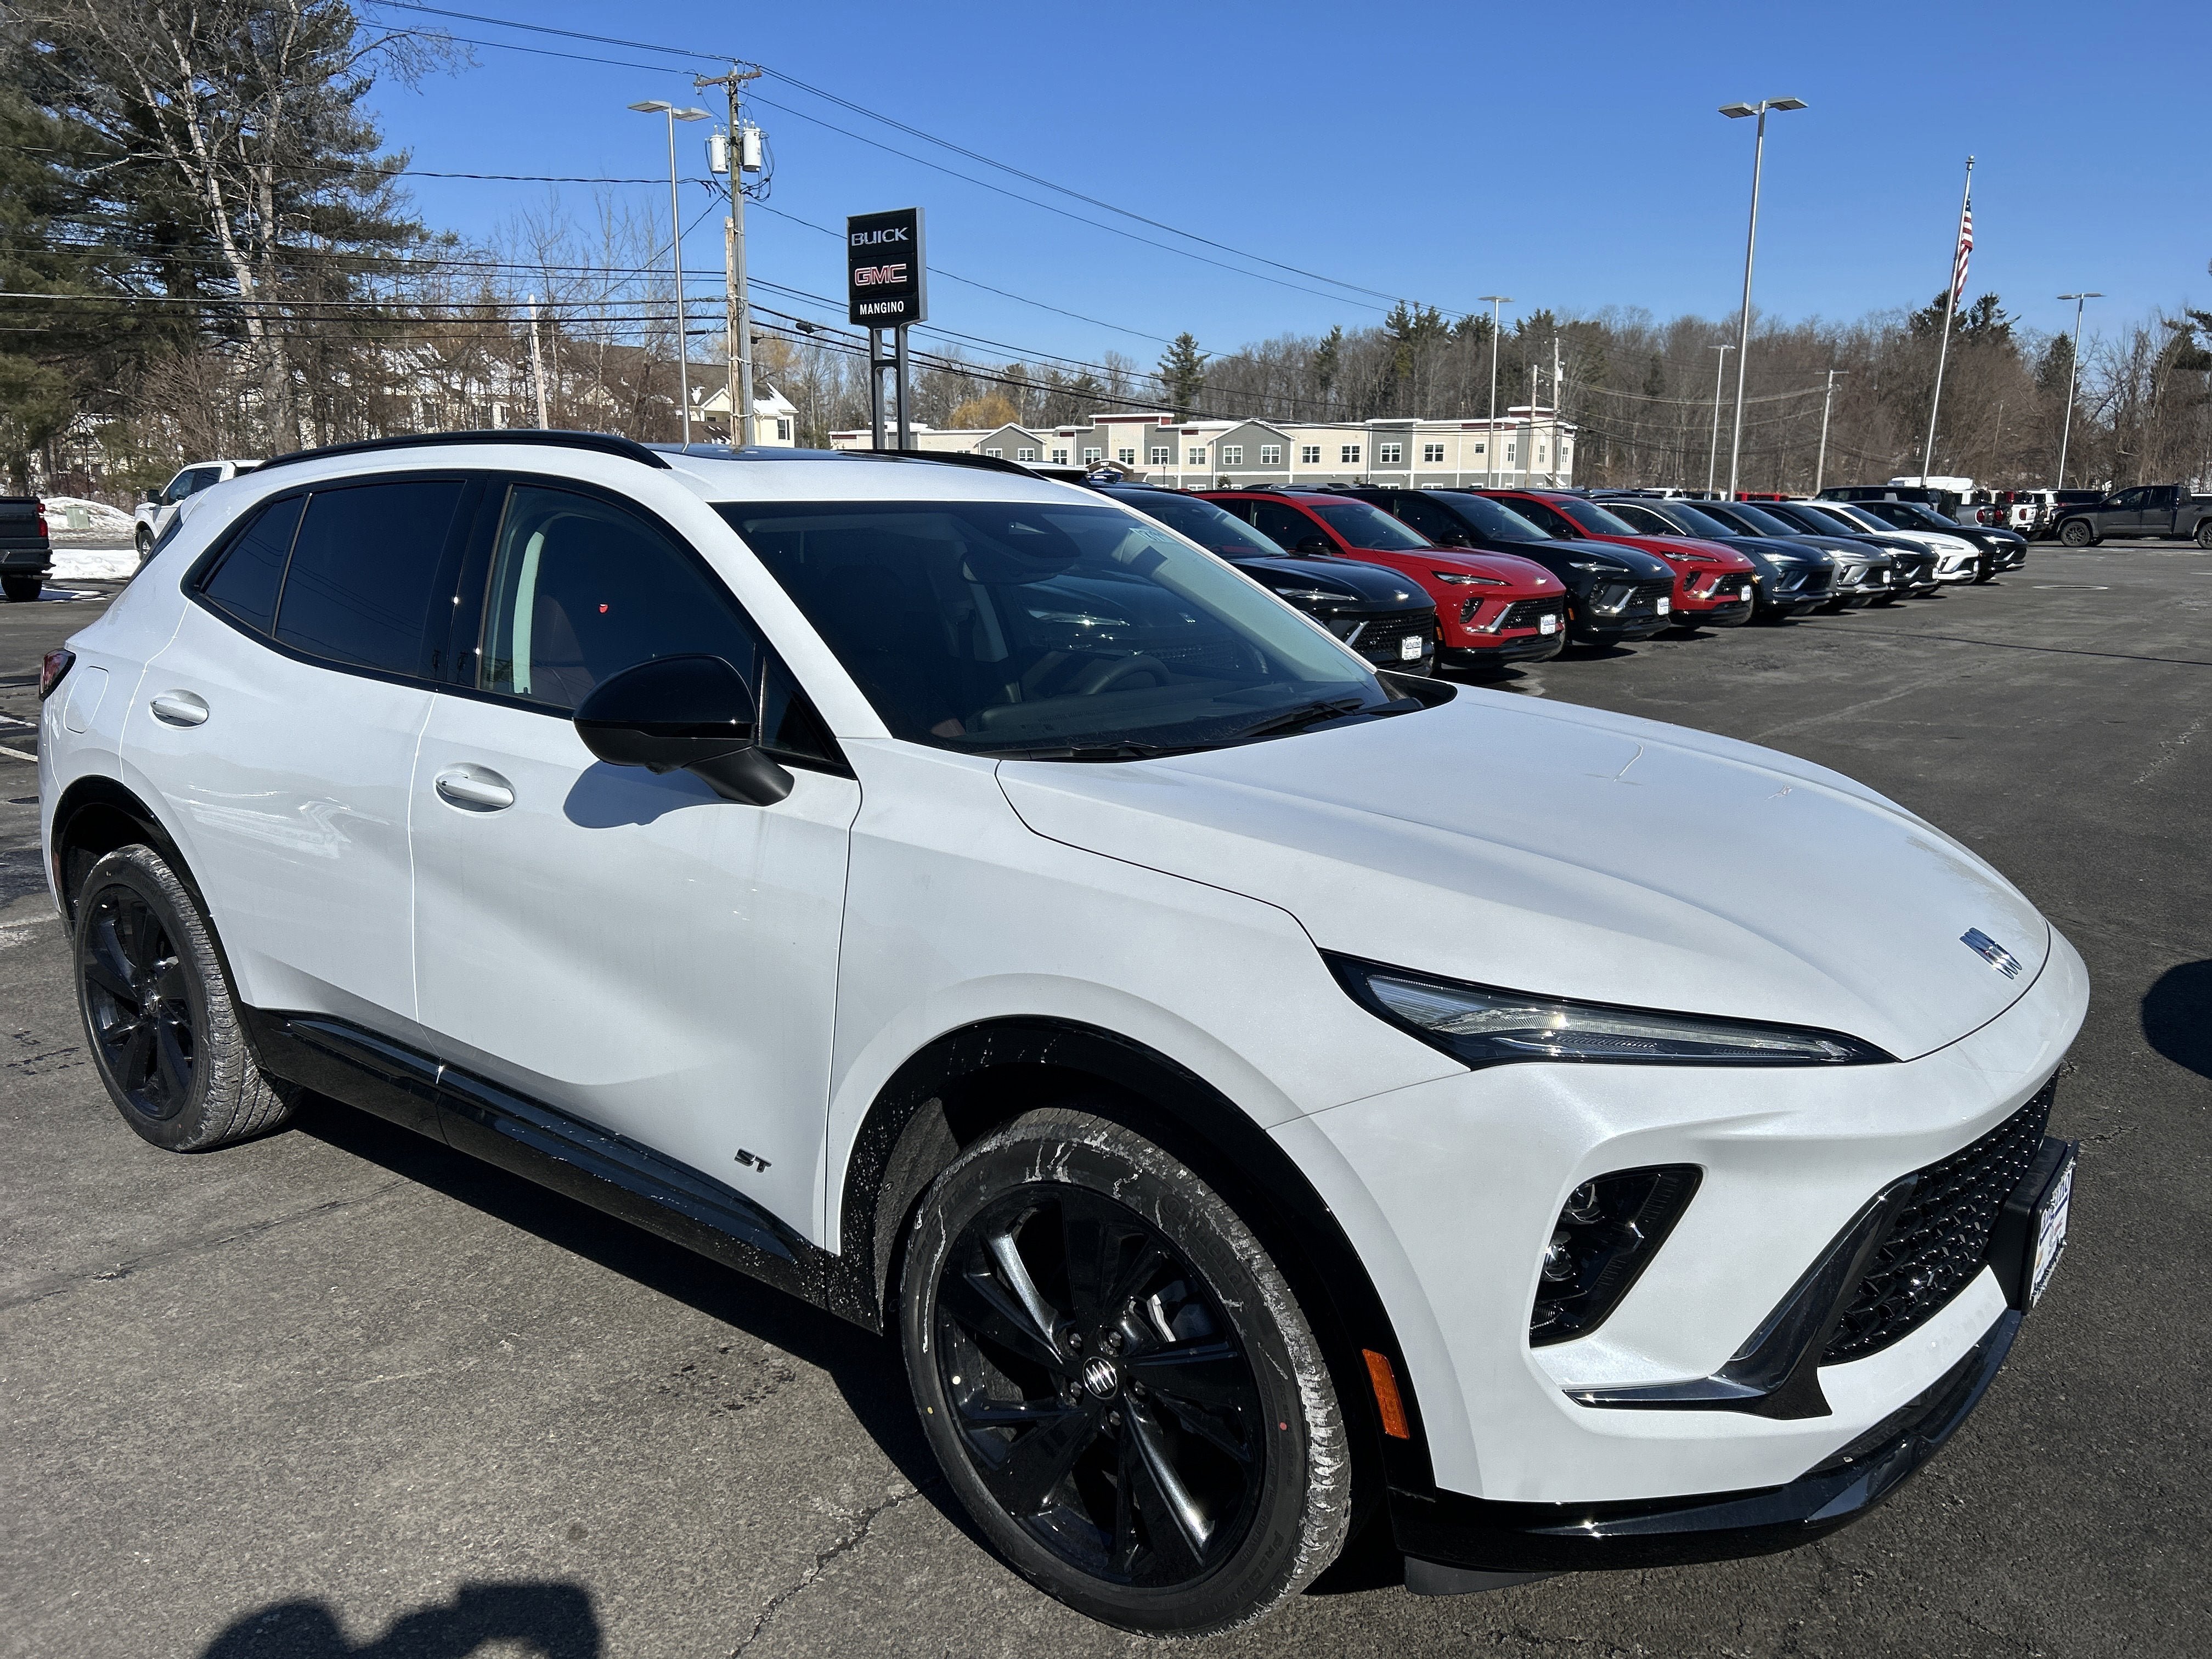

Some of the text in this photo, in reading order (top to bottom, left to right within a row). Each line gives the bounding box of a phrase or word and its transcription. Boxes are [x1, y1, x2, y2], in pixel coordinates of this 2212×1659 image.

[851, 227, 909, 246] BUICK
[854, 263, 907, 286] GMC
[860, 301, 904, 315] MANGINO
[734, 1148, 772, 1173] ST
